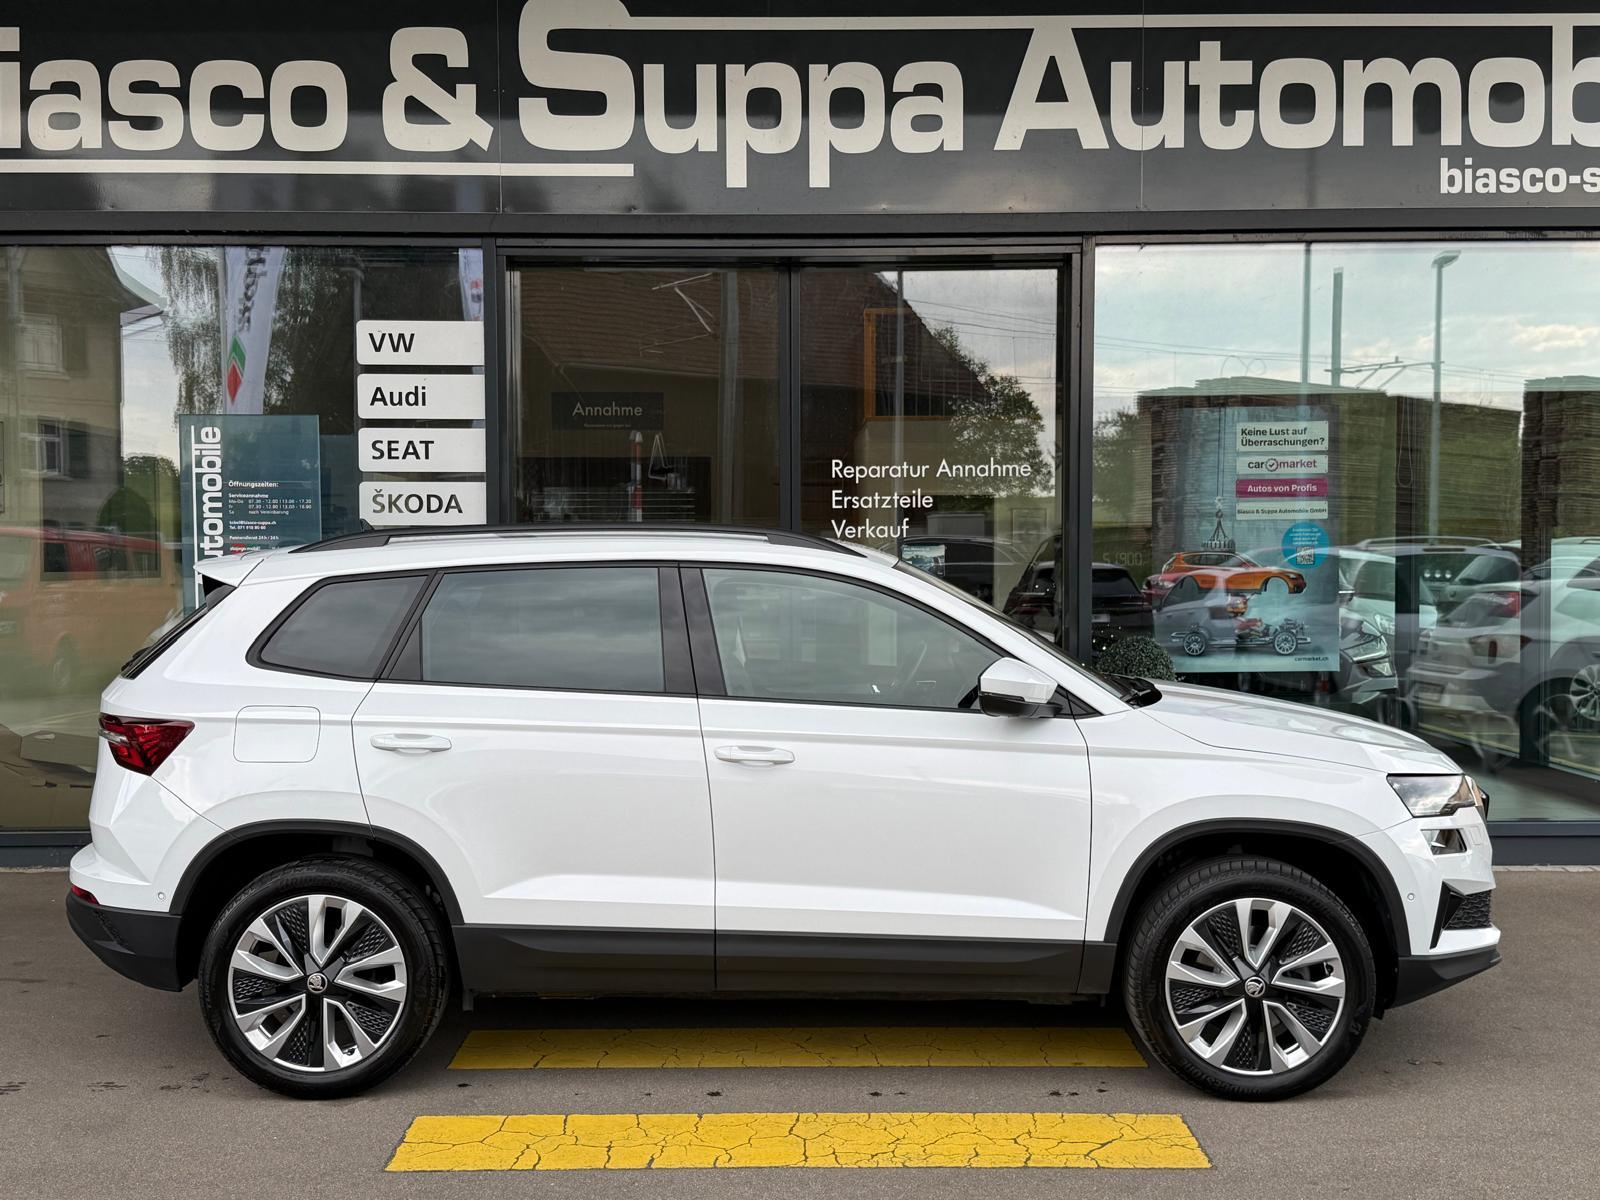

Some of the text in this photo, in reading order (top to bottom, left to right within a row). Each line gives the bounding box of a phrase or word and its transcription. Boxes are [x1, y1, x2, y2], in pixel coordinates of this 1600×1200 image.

[382, 26, 494, 152] &
[518, 0, 964, 188] Suppa
[1440, 157, 1600, 194] biasco-s
[368, 333, 415, 353] VW
[369, 386, 427, 407] Audi
[572, 400, 643, 417] Annahme
[1240, 427, 1308, 436] Keine Lust auf
[371, 440, 435, 460] SEAT
[1240, 436, 1325, 448] Überraschungen?
[831, 457, 1032, 484] Reparatur Annahme
[228, 480, 279, 488] Öffnungszeiten:
[1247, 484, 1272, 493] Autos
[1291, 483, 1318, 492] Profis
[372, 488, 463, 514] ŠKODA
[831, 488, 934, 509] Ersatzteile
[831, 517, 910, 539] Verkauf
